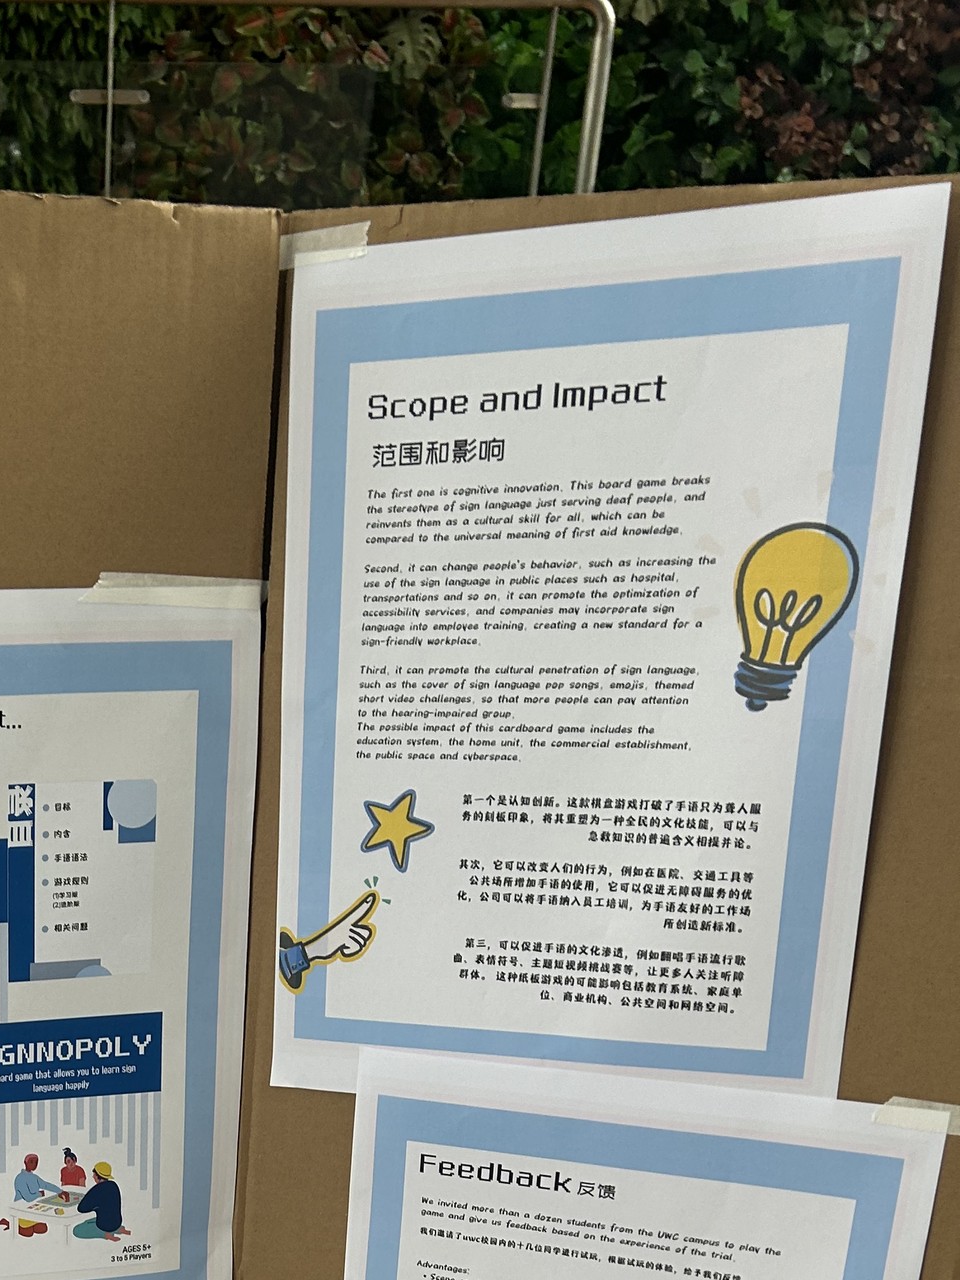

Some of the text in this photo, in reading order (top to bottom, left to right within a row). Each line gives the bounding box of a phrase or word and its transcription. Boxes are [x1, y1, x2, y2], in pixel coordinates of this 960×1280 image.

[367, 375, 668, 422] Scope and Impact
[372, 437, 505, 468] 范围和影响
[361, 635, 482, 648] sign-friendly workplace.
[356, 750, 521, 762] the public space and cyberspace.
[54, 802, 72, 812] 目标
[54, 852, 88, 863] 手语语法
[14, 1072, 33, 1083] game
[35, 1069, 52, 1080] that
[53, 1068, 75, 1078] allows
[76, 1068, 90, 1078] you
[91, 1065, 100, 1076] to
[101, 1065, 120, 1075] learn
[121, 1064, 137, 1074] sign
[32, 1079, 90, 1093] language happily
[419, 1153, 616, 1201] Feedback 反馈
[122, 1243, 152, 1254] AGES 5+
[110, 1255, 116, 1263] 3
[128, 1252, 152, 1261] Players
[416, 1260, 470, 1274] Advantages:
